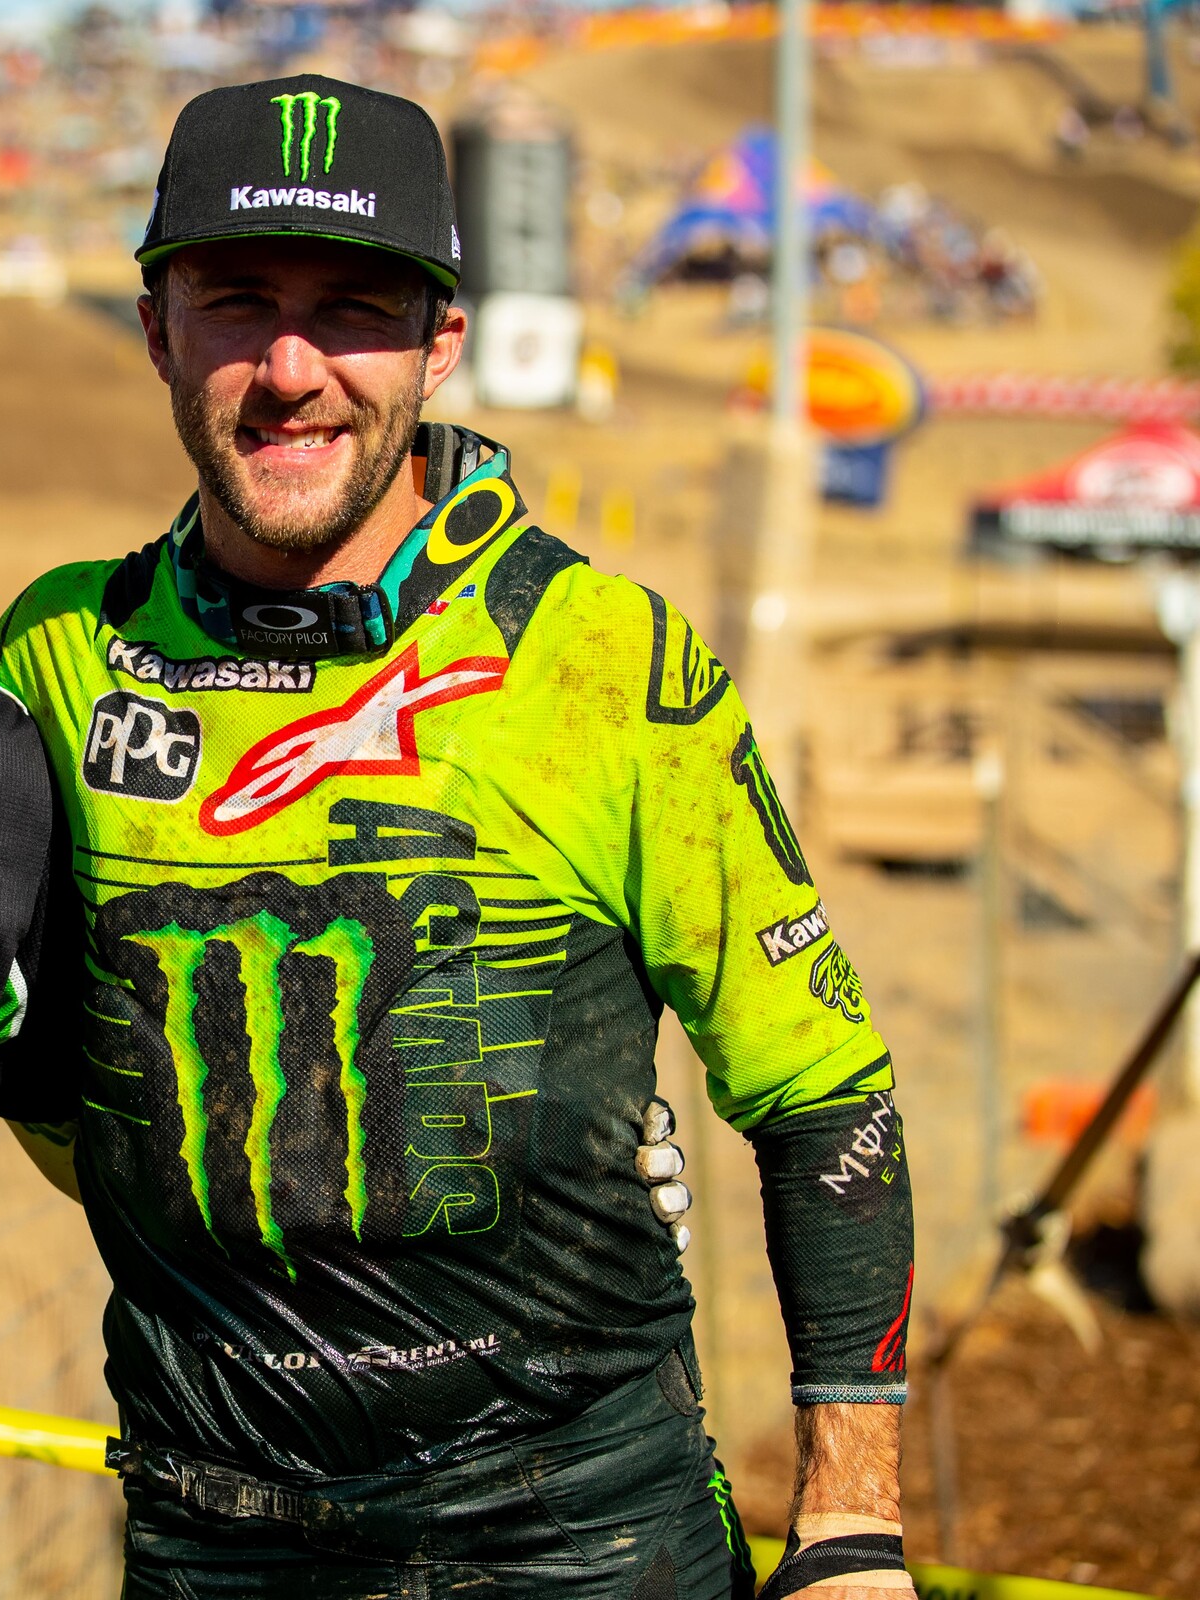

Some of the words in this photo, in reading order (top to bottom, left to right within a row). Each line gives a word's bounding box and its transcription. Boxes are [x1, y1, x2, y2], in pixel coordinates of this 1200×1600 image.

[229, 185, 376, 218] Kawasaki
[108, 637, 312, 690] Kawasaki
[240, 629, 293, 645] FACTORY
[296, 631, 329, 645] PILOT
[761, 900, 831, 962] Kaw
[818, 1091, 895, 1195] MON
